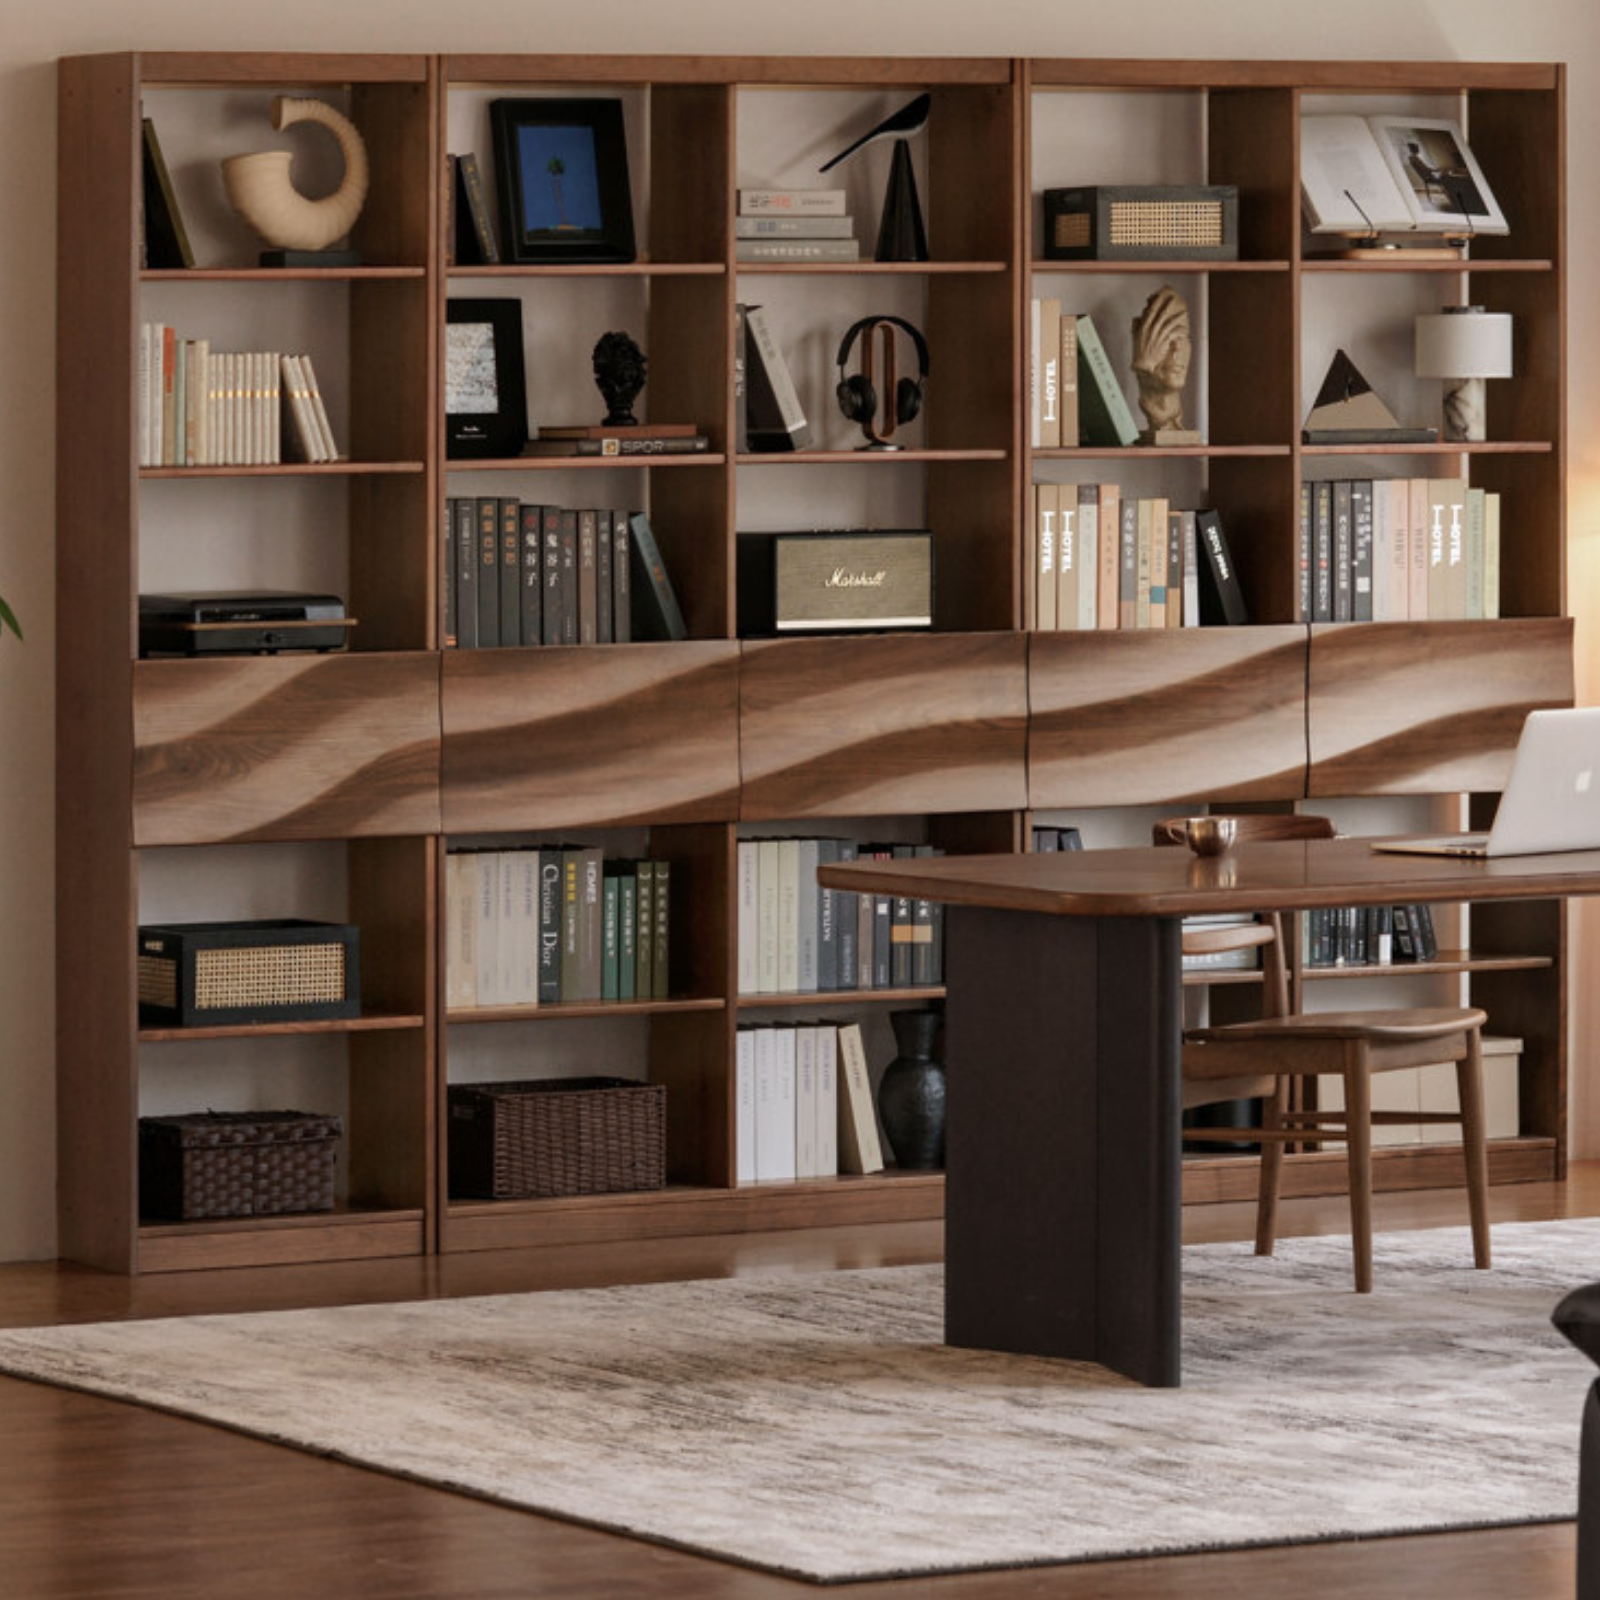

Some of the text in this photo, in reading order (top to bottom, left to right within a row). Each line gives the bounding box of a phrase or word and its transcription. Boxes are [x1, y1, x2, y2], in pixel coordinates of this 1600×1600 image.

[825, 567, 887, 587] Marshall
[542, 863, 559, 966] Christian Dior
